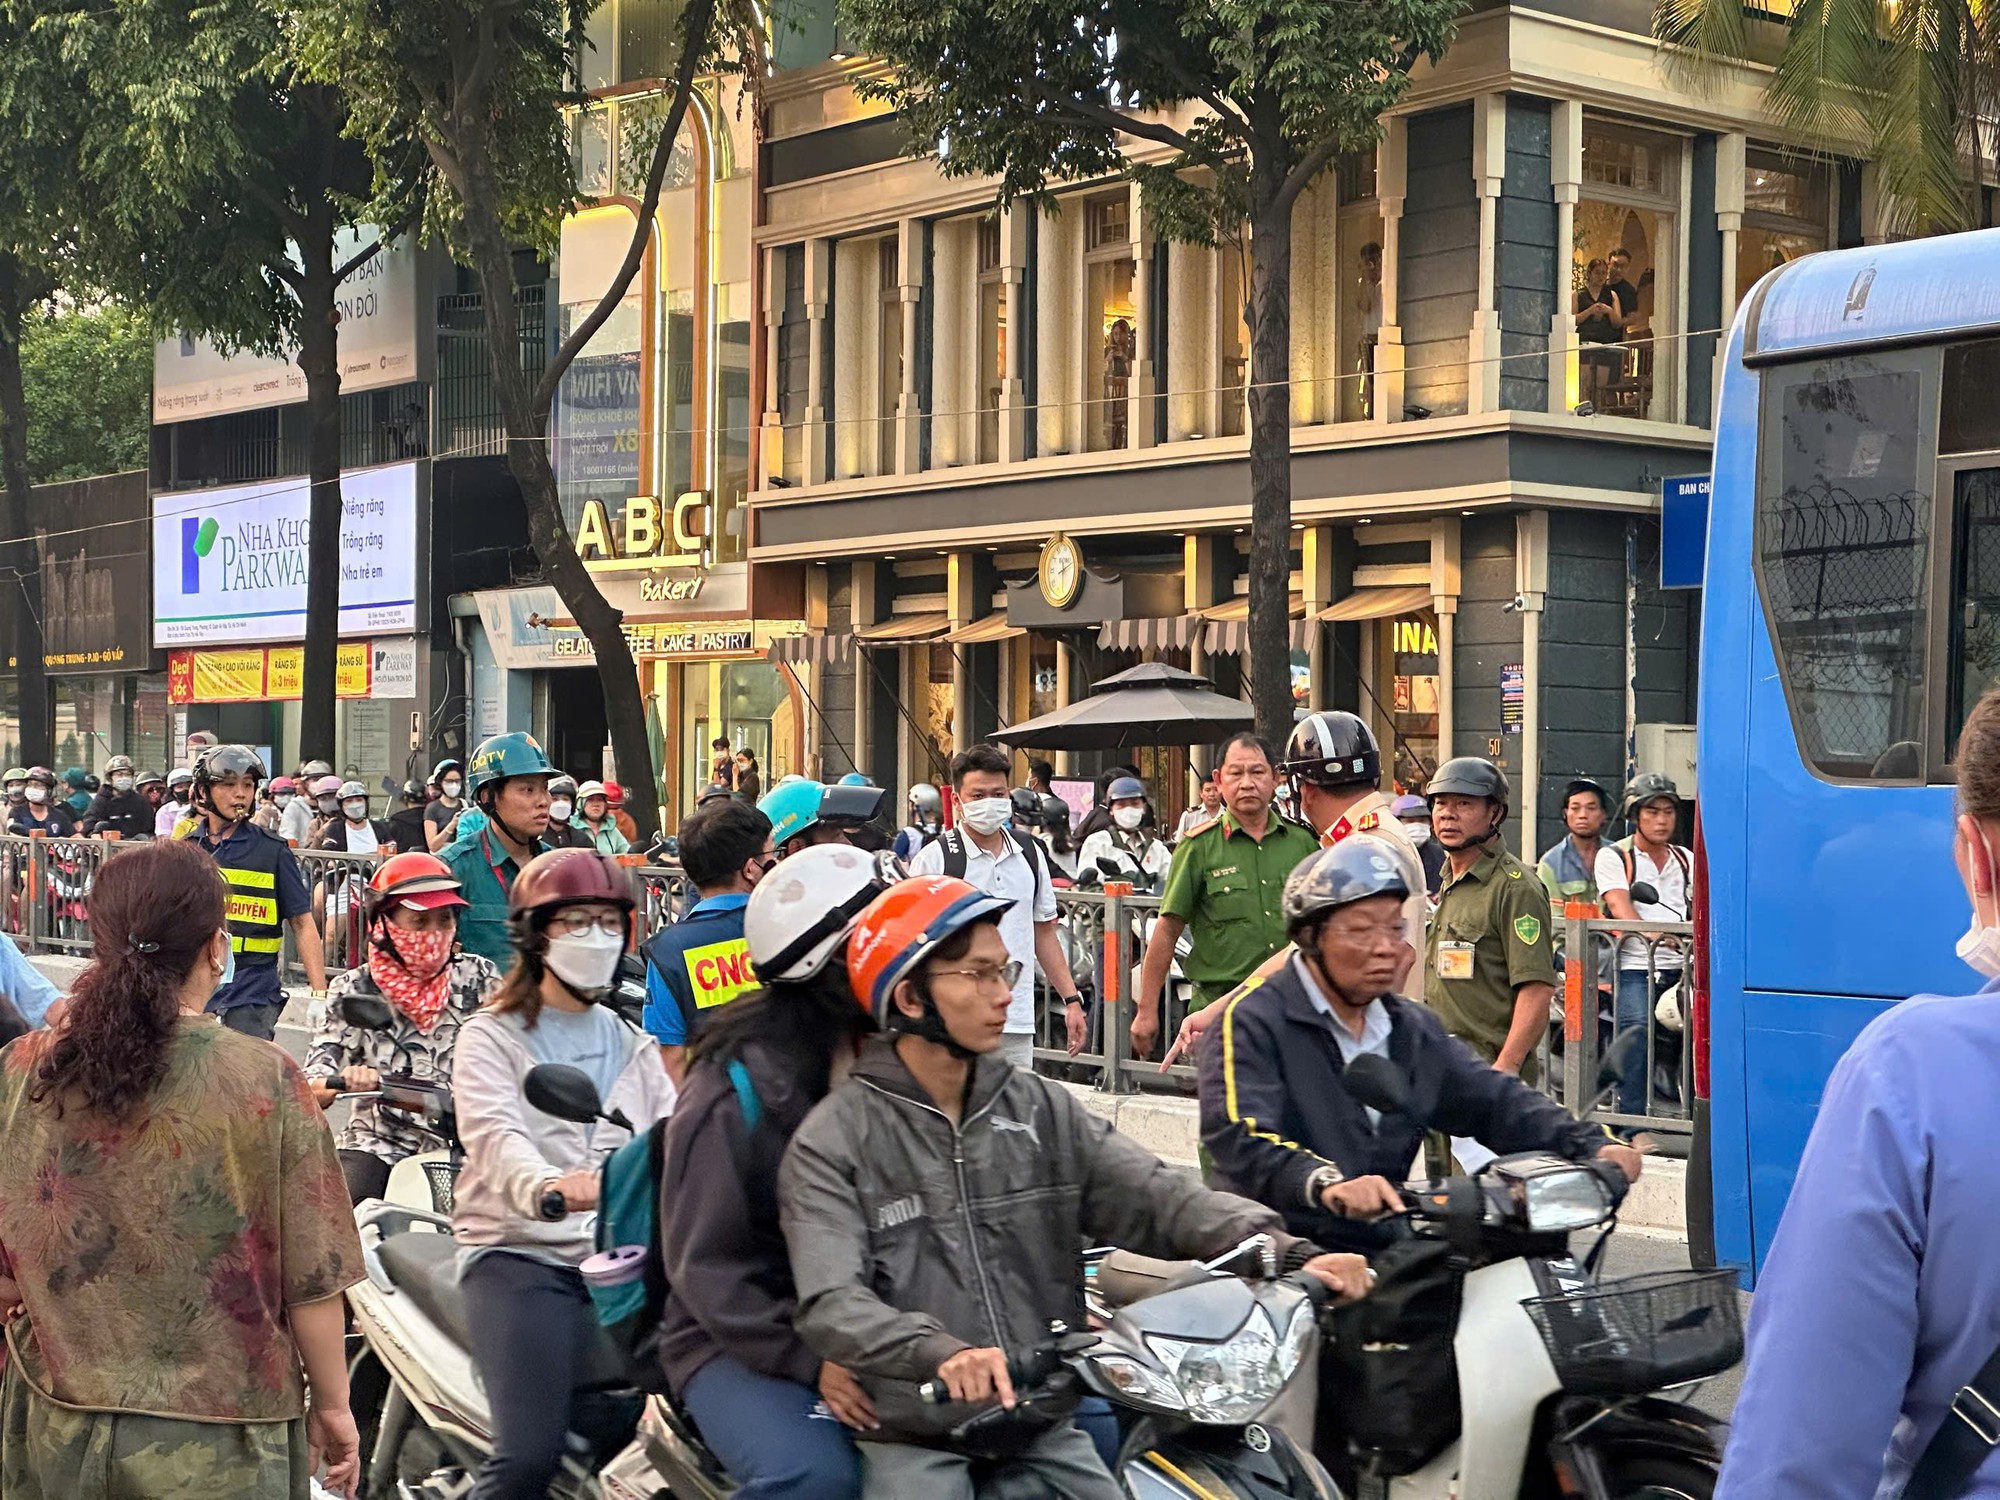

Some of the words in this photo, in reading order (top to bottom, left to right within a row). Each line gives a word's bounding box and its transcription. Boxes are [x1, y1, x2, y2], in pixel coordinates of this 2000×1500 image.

[336, 298, 353, 329] ỌN
[356, 287, 378, 319] ĐỜI
[573, 372, 611, 398] WIFI
[616, 370, 641, 395] VN
[1679, 483, 1697, 496] BAN
[1698, 482, 1711, 494] CH
[238, 522, 274, 552] NHA
[277, 517, 311, 549] KHO
[574, 491, 703, 557] ABC
[221, 535, 309, 592] PARKWA
[342, 563, 358, 581] Nha
[371, 567, 383, 578] em
[639, 576, 703, 601] Bakery
[661, 634, 696, 652] CAKE
[701, 632, 748, 651] PASTRY
[171, 657, 190, 675] Deal
[173, 676, 187, 696] sốc
[278, 674, 283, 687] 3
[1489, 738, 1501, 756] 50
[472, 749, 506, 772] DQTV
